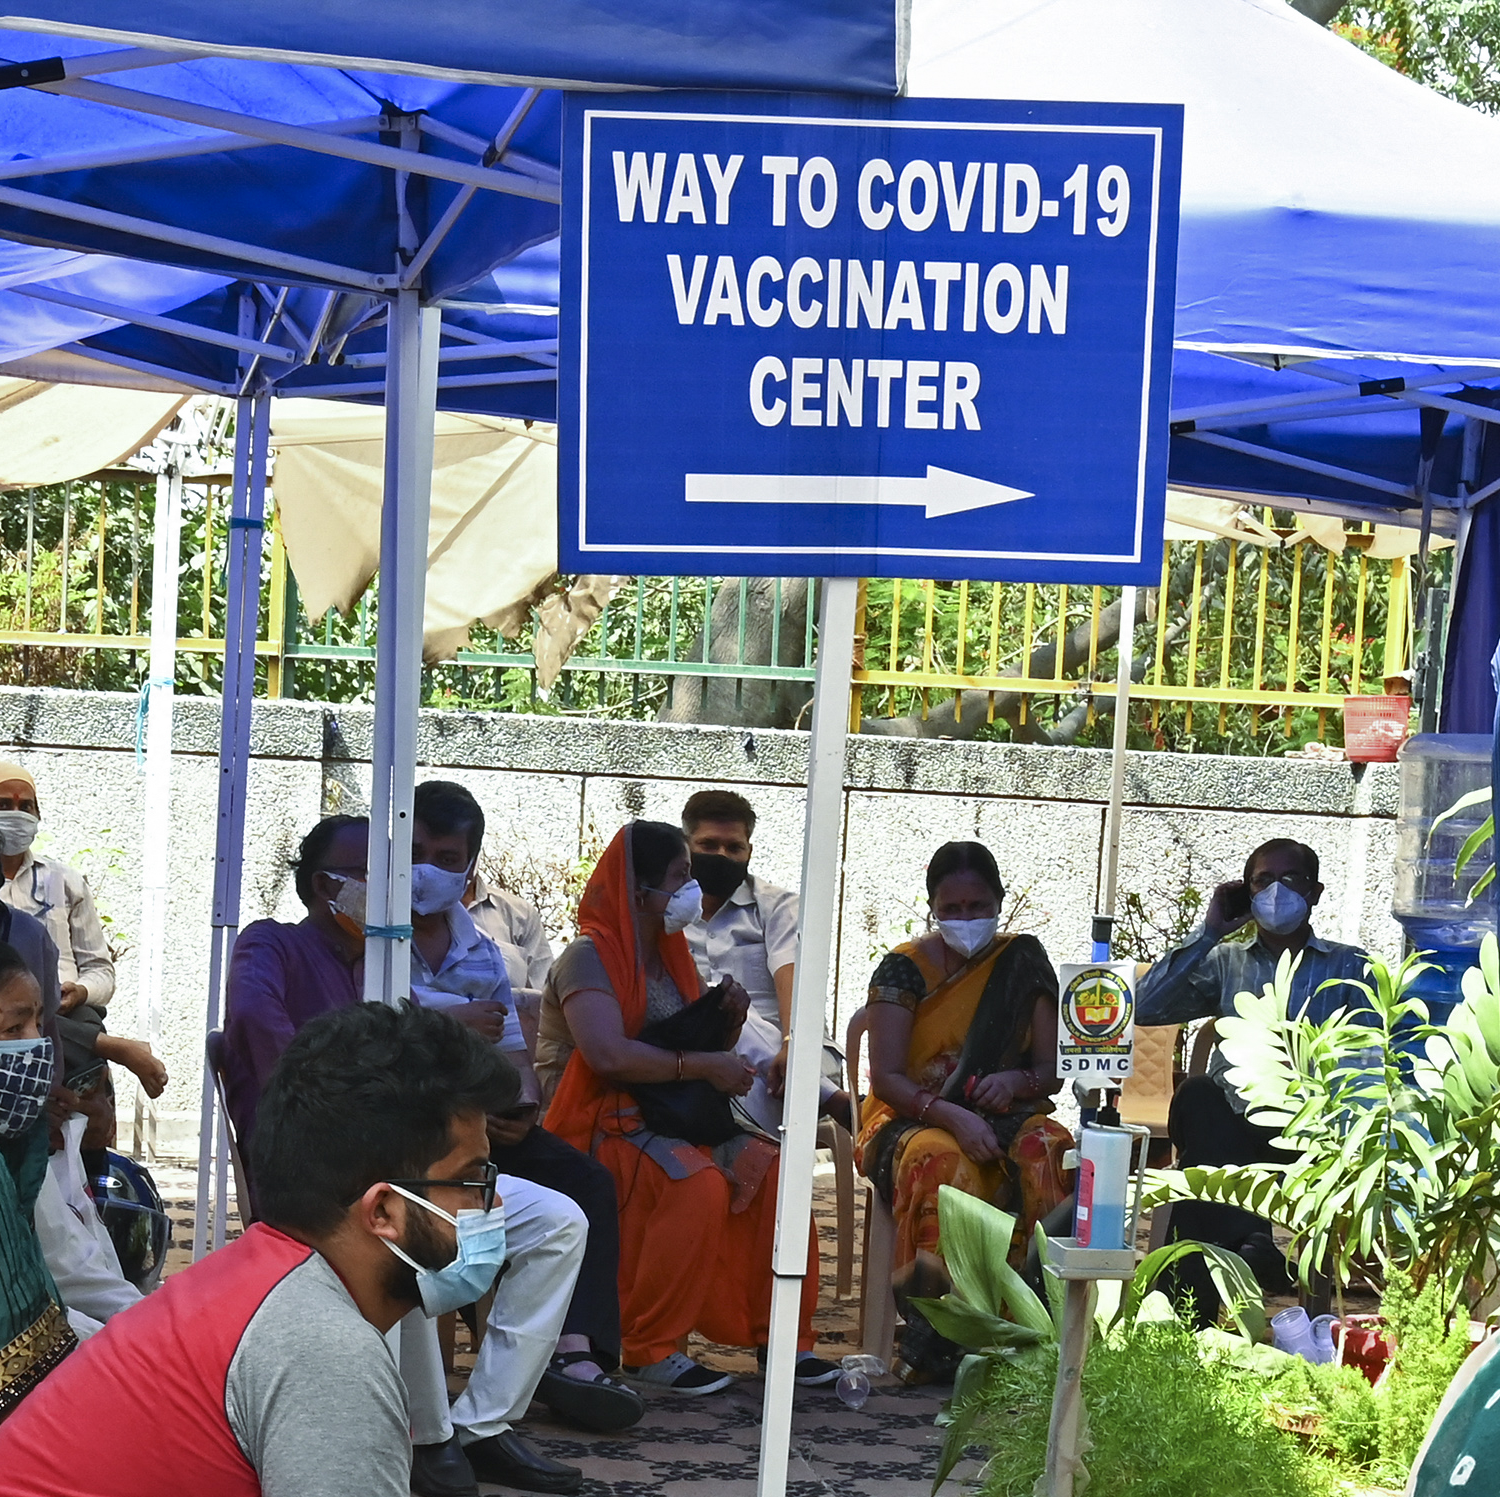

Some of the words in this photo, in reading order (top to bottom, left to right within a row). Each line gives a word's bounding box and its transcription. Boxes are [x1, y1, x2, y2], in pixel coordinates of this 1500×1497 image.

[611, 150, 744, 225] WAY
[761, 155, 839, 230] TO
[856, 158, 1132, 238] COVID-19
[666, 254, 1070, 335] VACCINATION
[748, 355, 983, 432] CENTER
